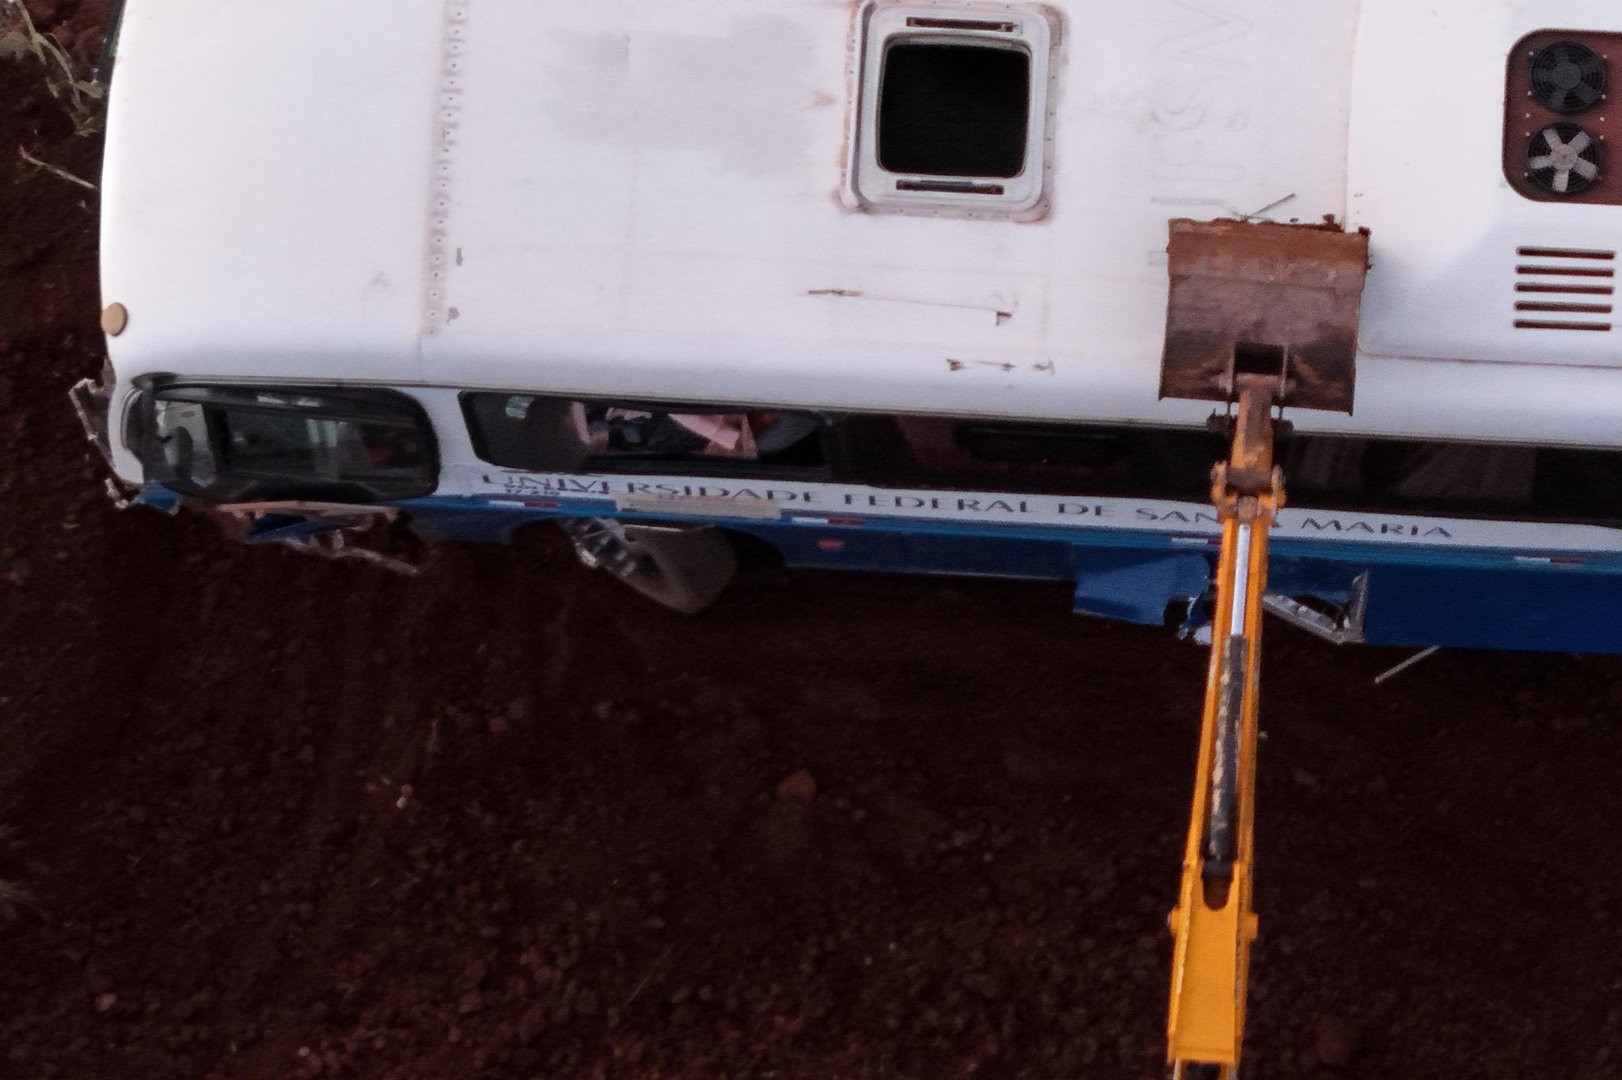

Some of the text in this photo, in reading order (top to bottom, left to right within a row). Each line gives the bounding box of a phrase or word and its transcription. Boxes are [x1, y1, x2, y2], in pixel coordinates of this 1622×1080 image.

[482, 474, 818, 503] UNIVERSIDADE
[844, 493, 1038, 513] FEDERAL
[1057, 502, 1115, 517] DE
[1301, 517, 1452, 538] MARIA
